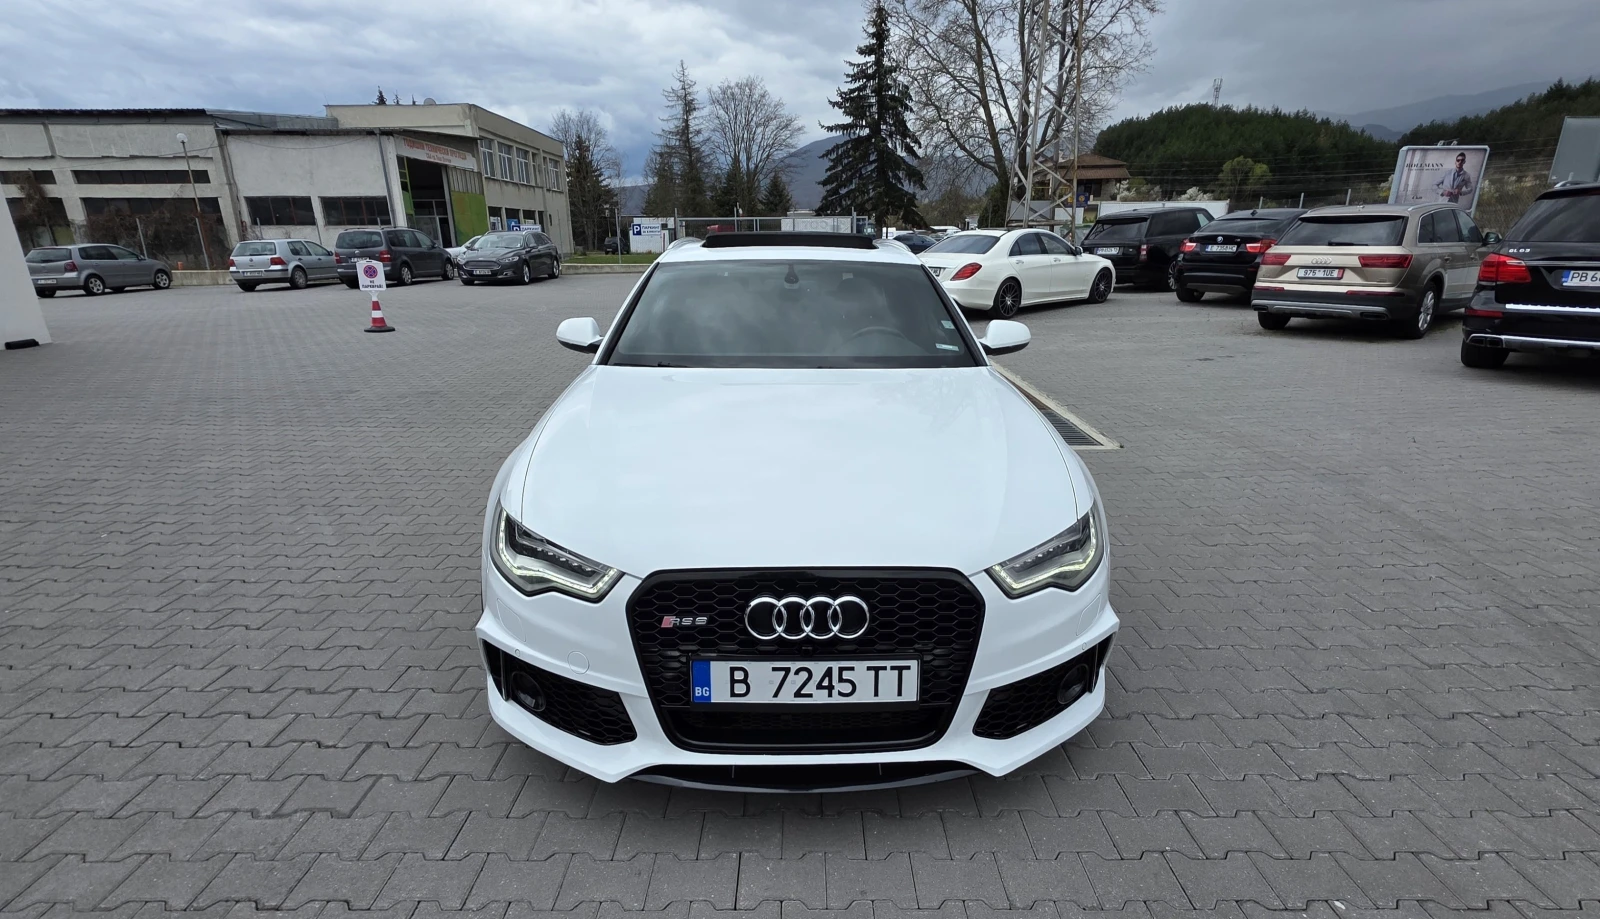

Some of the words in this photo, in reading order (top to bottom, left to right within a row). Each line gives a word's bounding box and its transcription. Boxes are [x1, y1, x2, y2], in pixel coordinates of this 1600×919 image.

[633, 225, 640, 235] P
[1570, 272, 1588, 282] PB
[1590, 272, 1600, 282] 6
[694, 686, 710, 696] BG
[729, 666, 751, 698] B
[771, 666, 857, 698] 7245
[866, 665, 911, 697] TT
